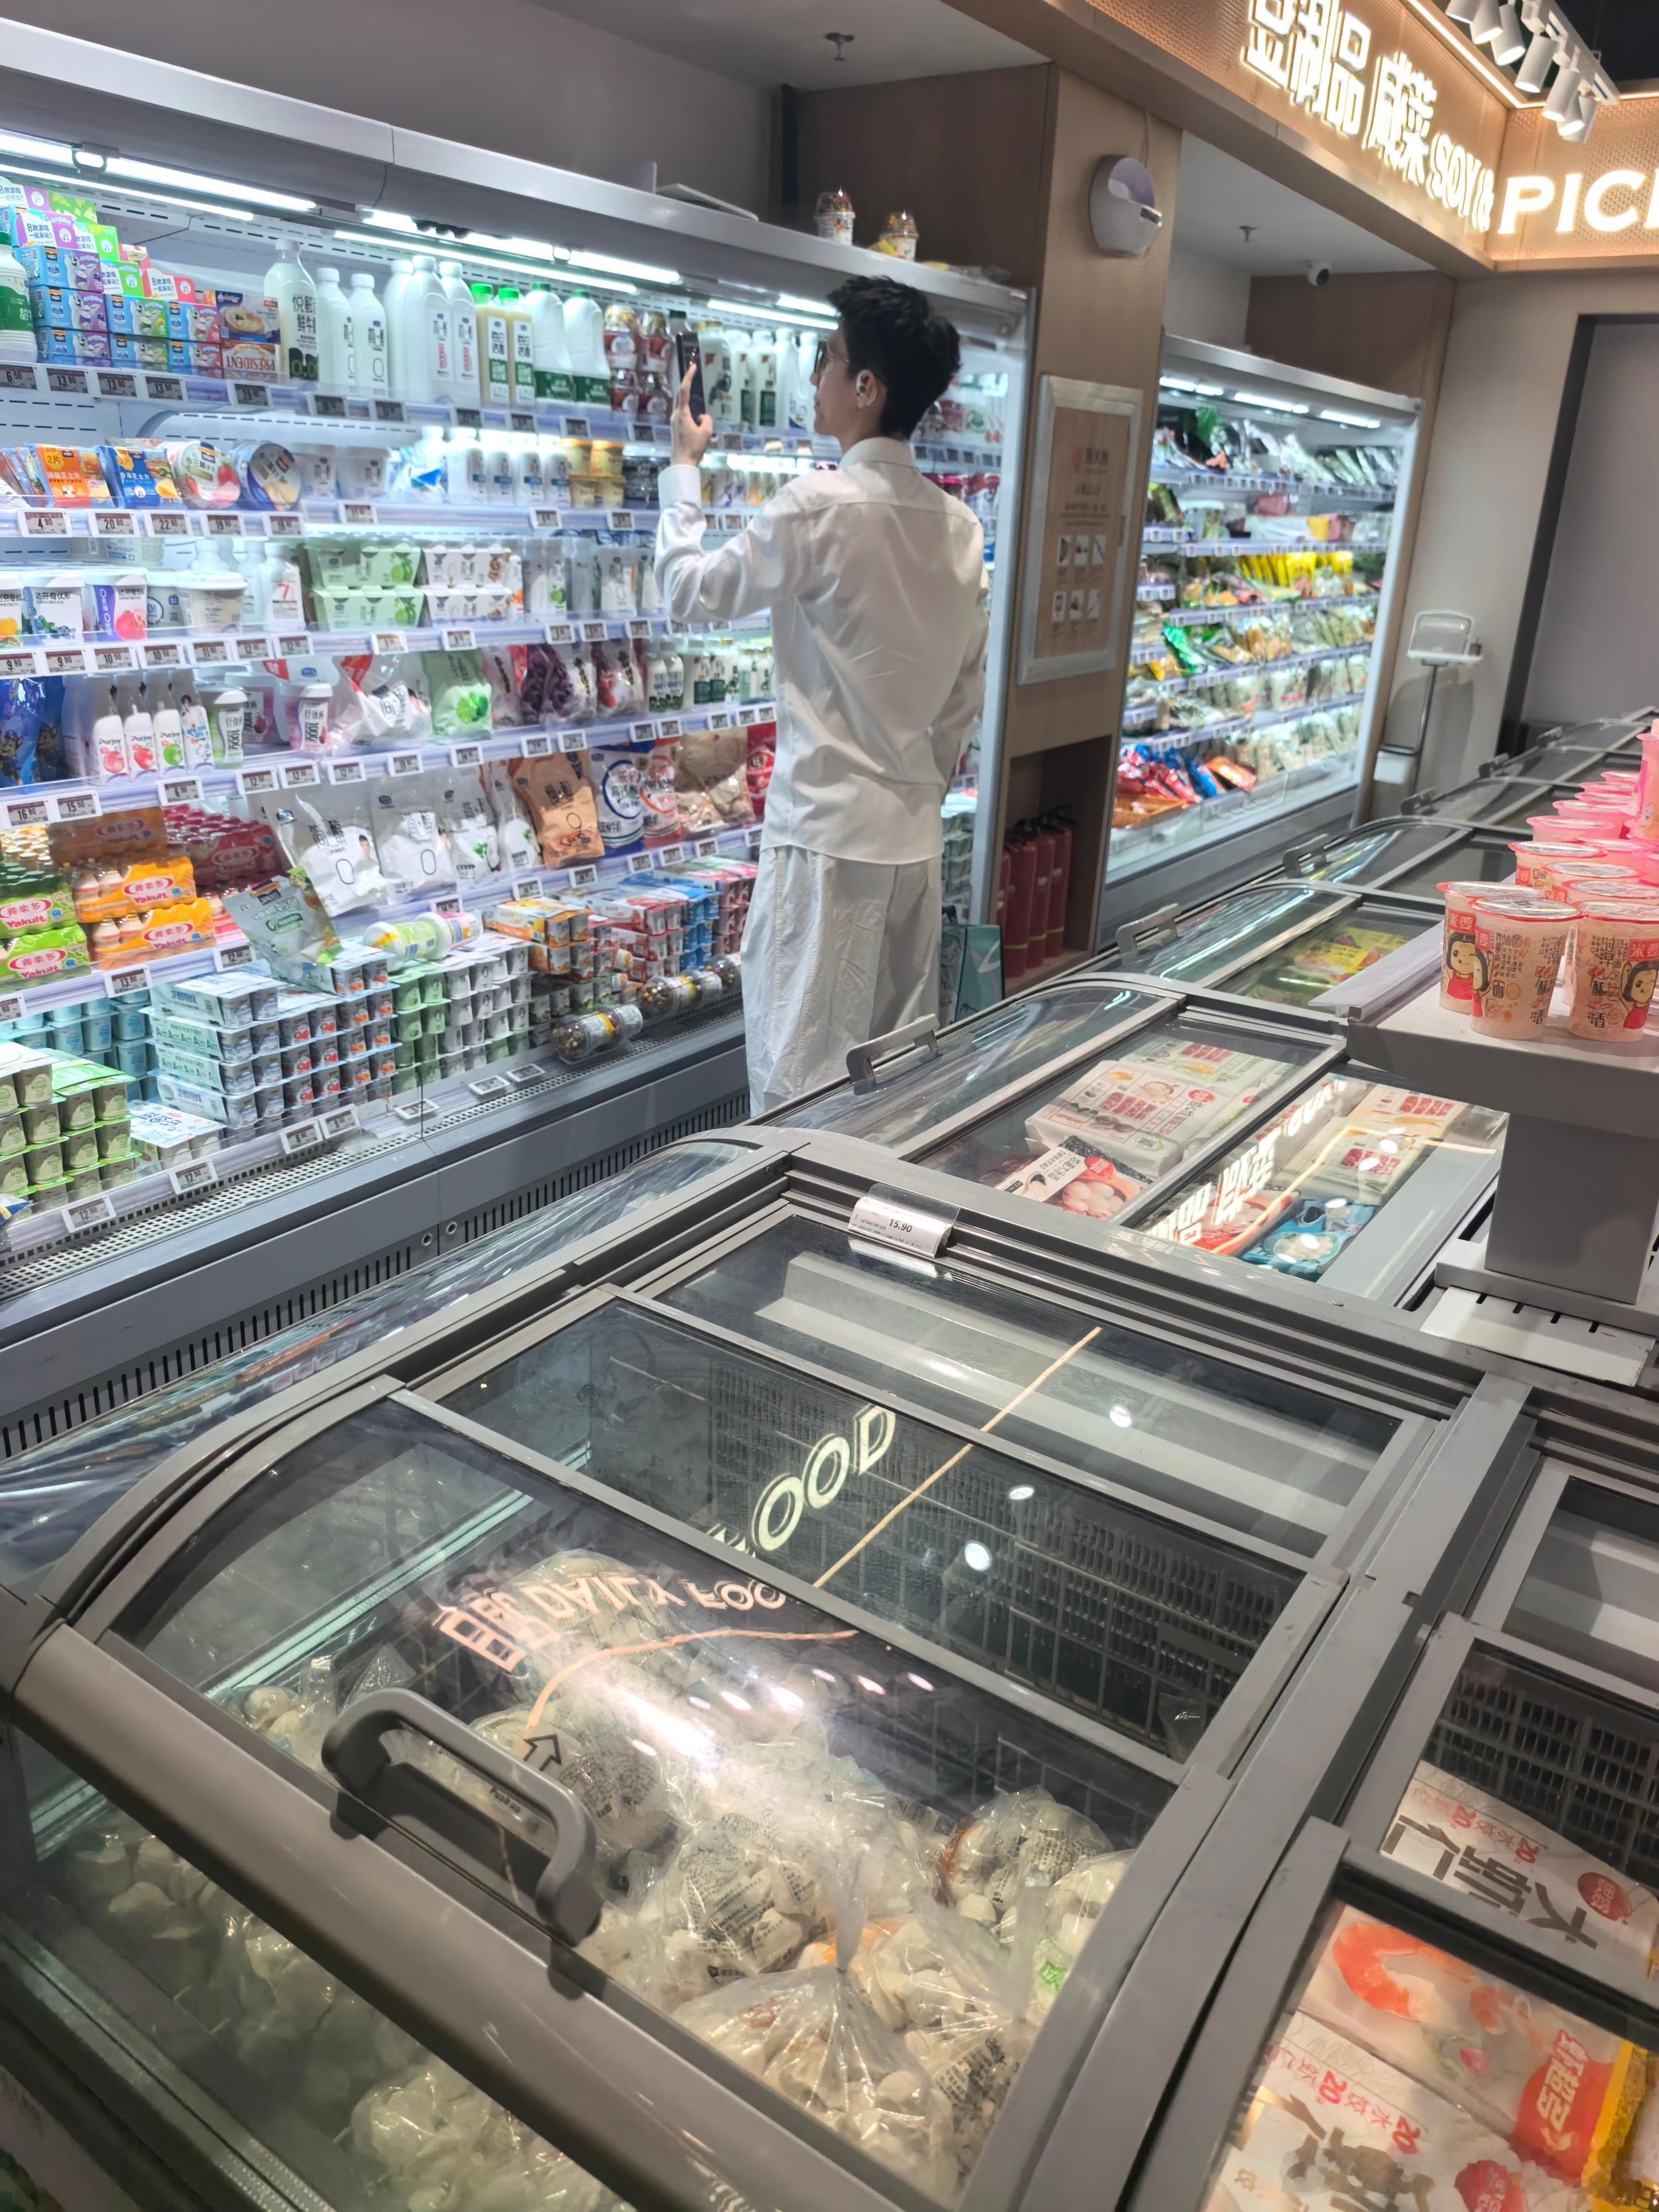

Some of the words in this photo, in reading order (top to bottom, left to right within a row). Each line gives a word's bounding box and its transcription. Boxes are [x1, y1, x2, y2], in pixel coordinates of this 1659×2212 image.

[1498, 170, 1659, 235] PIC
[6, 659, 22, 671] 9.90
[134, 892, 168, 905] Yakult
[5, 914, 46, 928] Yakult
[889, 1218, 913, 1233] 15.90
[489, 1786, 510, 1805] Push
[1381, 1815, 1599, 1950] 大虾仁
[1535, 2028, 1593, 2126] 虾超多
